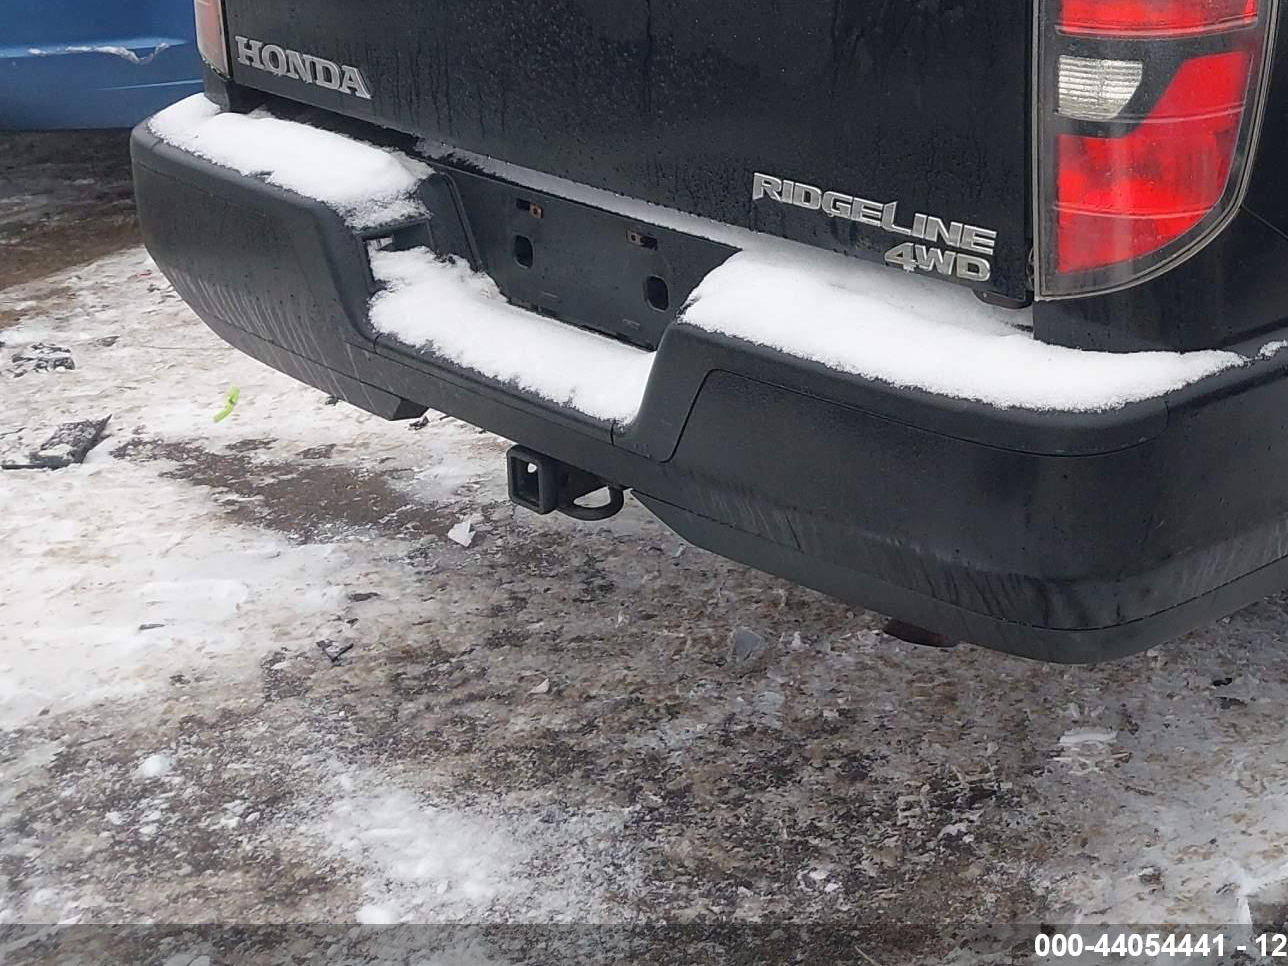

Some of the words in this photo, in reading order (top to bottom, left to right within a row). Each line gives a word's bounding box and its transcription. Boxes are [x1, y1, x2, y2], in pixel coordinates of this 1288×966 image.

[235, 36, 372, 100] HONDA
[752, 172, 997, 256] RIDGELINE
[884, 242, 991, 282] 4WD
